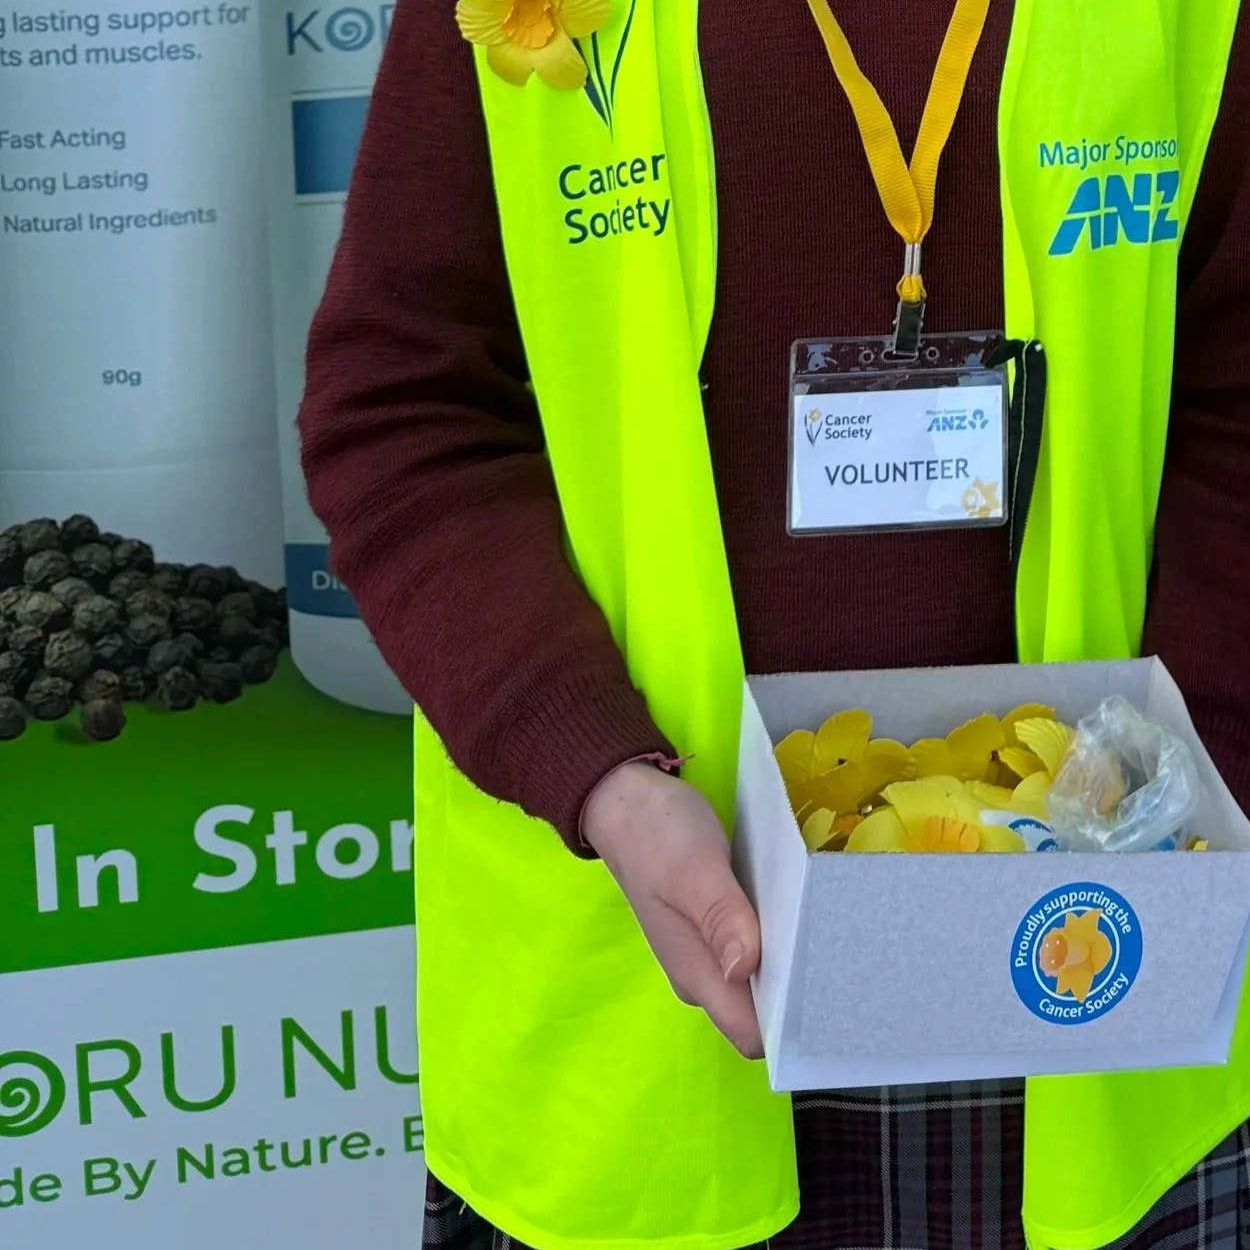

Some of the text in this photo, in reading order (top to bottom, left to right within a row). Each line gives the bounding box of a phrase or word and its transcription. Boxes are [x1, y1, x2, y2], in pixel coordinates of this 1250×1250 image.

[12, 10, 100, 37] lasting
[107, 5, 212, 34] support
[218, 3, 251, 25] for
[29, 44, 77, 66] and
[85, 40, 203, 64] muscles.
[0, 128, 127, 151] Fast Acting
[1039, 138, 1111, 171] Major
[1, 170, 149, 195] Long Lasting
[558, 153, 666, 200] Cancer
[4, 207, 218, 234] Natural Ingredients
[564, 196, 671, 244] Society
[1048, 170, 1180, 256] ANZ
[102, 369, 142, 387] 90g
[825, 414, 872, 426] Cancer
[825, 427, 873, 441] Society
[926, 415, 968, 432] ANZ
[825, 458, 970, 486] VOLUNTEER
[33, 824, 139, 913] In
[1015, 891, 1132, 968] Proudly supporting the
[1038, 972, 1129, 1018] Cancer Society
[83, 1156, 157, 1201] By
[176, 1130, 385, 1184] Nature.
